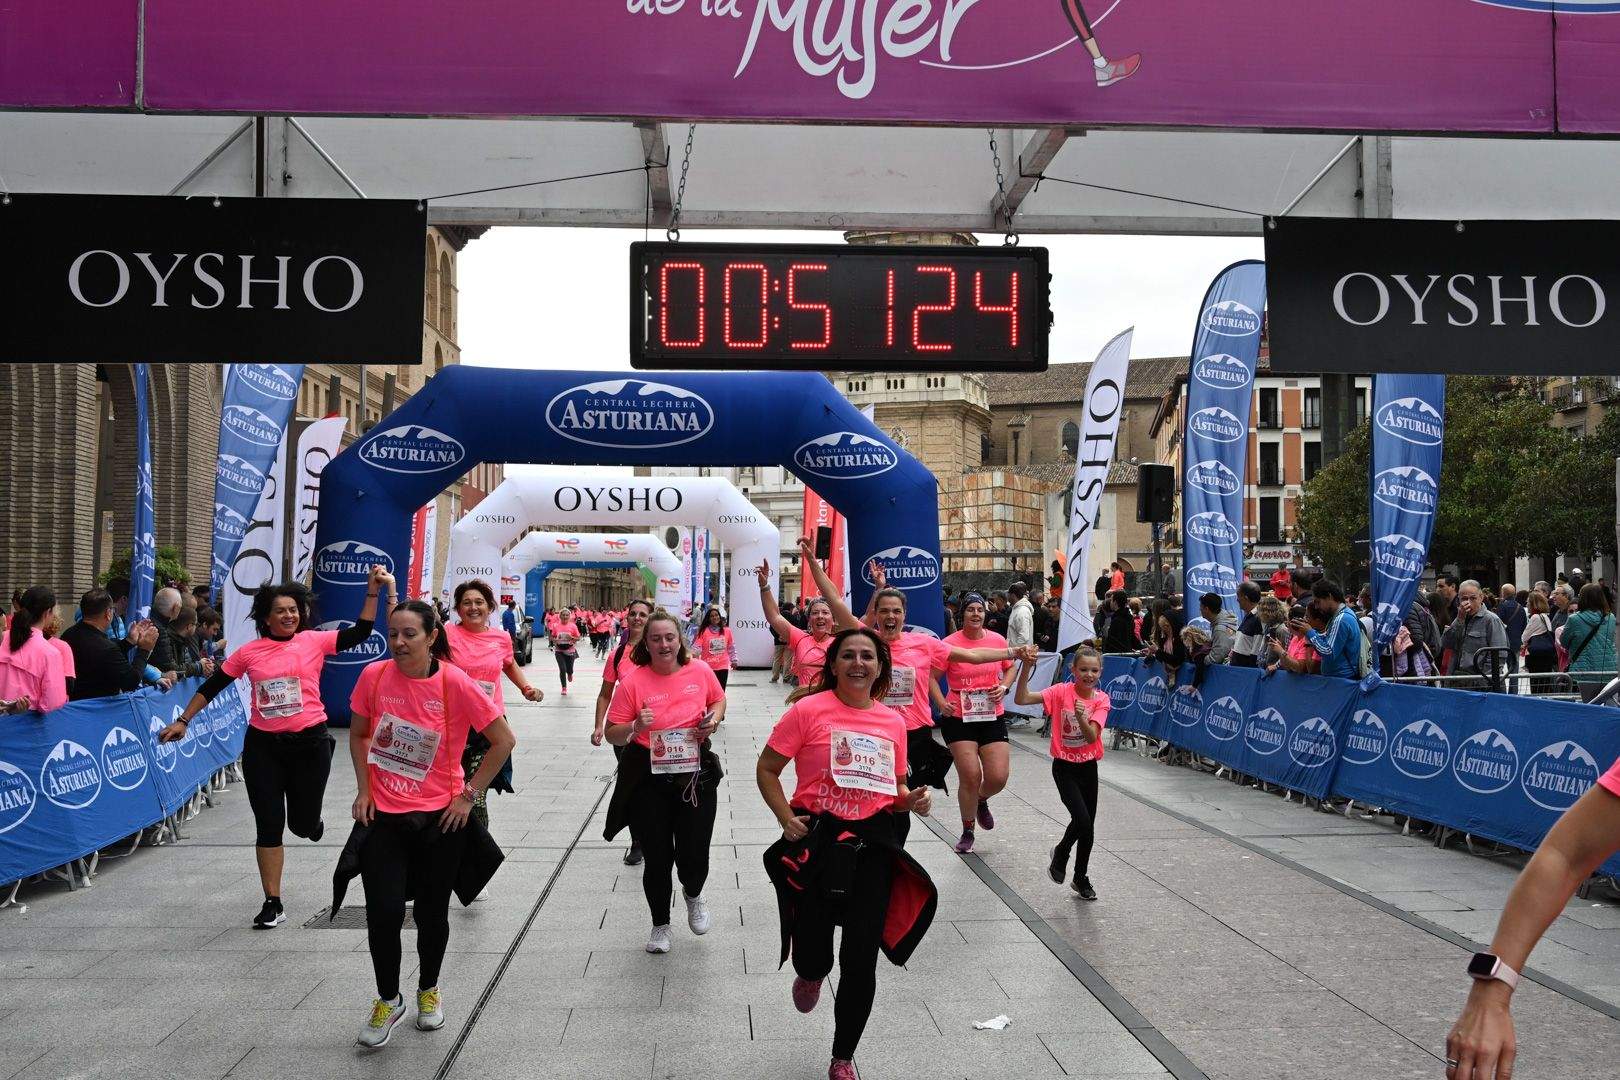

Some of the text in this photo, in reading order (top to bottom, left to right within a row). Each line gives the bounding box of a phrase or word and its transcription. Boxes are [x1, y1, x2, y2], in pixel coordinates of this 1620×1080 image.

[68, 250, 364, 312] OYSHO
[1333, 272, 1606, 327] OYSHO
[1208, 314, 1255, 331] ASTURIANA
[239, 365, 294, 398] ASTURIANA
[1198, 364, 1245, 383] ASTURIANA
[558, 400, 702, 431] ASTURIANA
[585, 399, 696, 409] CENTRAL LECHERA
[225, 409, 279, 444] ASTURIANA
[1194, 419, 1239, 437] ASTURIANA
[1383, 409, 1441, 438] ASTURIANA
[364, 441, 457, 463] ASTURIANA
[803, 450, 892, 468] ASTURIANA
[1068, 378, 1120, 590] OYSHO
[1191, 469, 1235, 490] ASTURIANA
[554, 487, 682, 512] OYSHO
[1376, 478, 1434, 507] ASTURIAN
[476, 514, 515, 524] OYSHO
[718, 515, 757, 524] OYSHO
[317, 556, 387, 574] ASTURIA
[456, 566, 493, 576] OYSHO
[738, 568, 774, 577] OYSO
[867, 565, 936, 579] TURIANA
[1207, 708, 1239, 732] ASTURIANA
[1247, 721, 1282, 745] ASTURIANA
[1347, 734, 1382, 754] TURIANA
[393, 740, 414, 753] 016
[1394, 737, 1445, 767] ASTURIANA
[108, 753, 146, 779] ASTURIANA
[854, 754, 875, 766] 016
[1456, 749, 1511, 782] ASTURIANA
[49, 767, 99, 797] ASTURIANA
[1525, 762, 1591, 796] ASTURIANA
